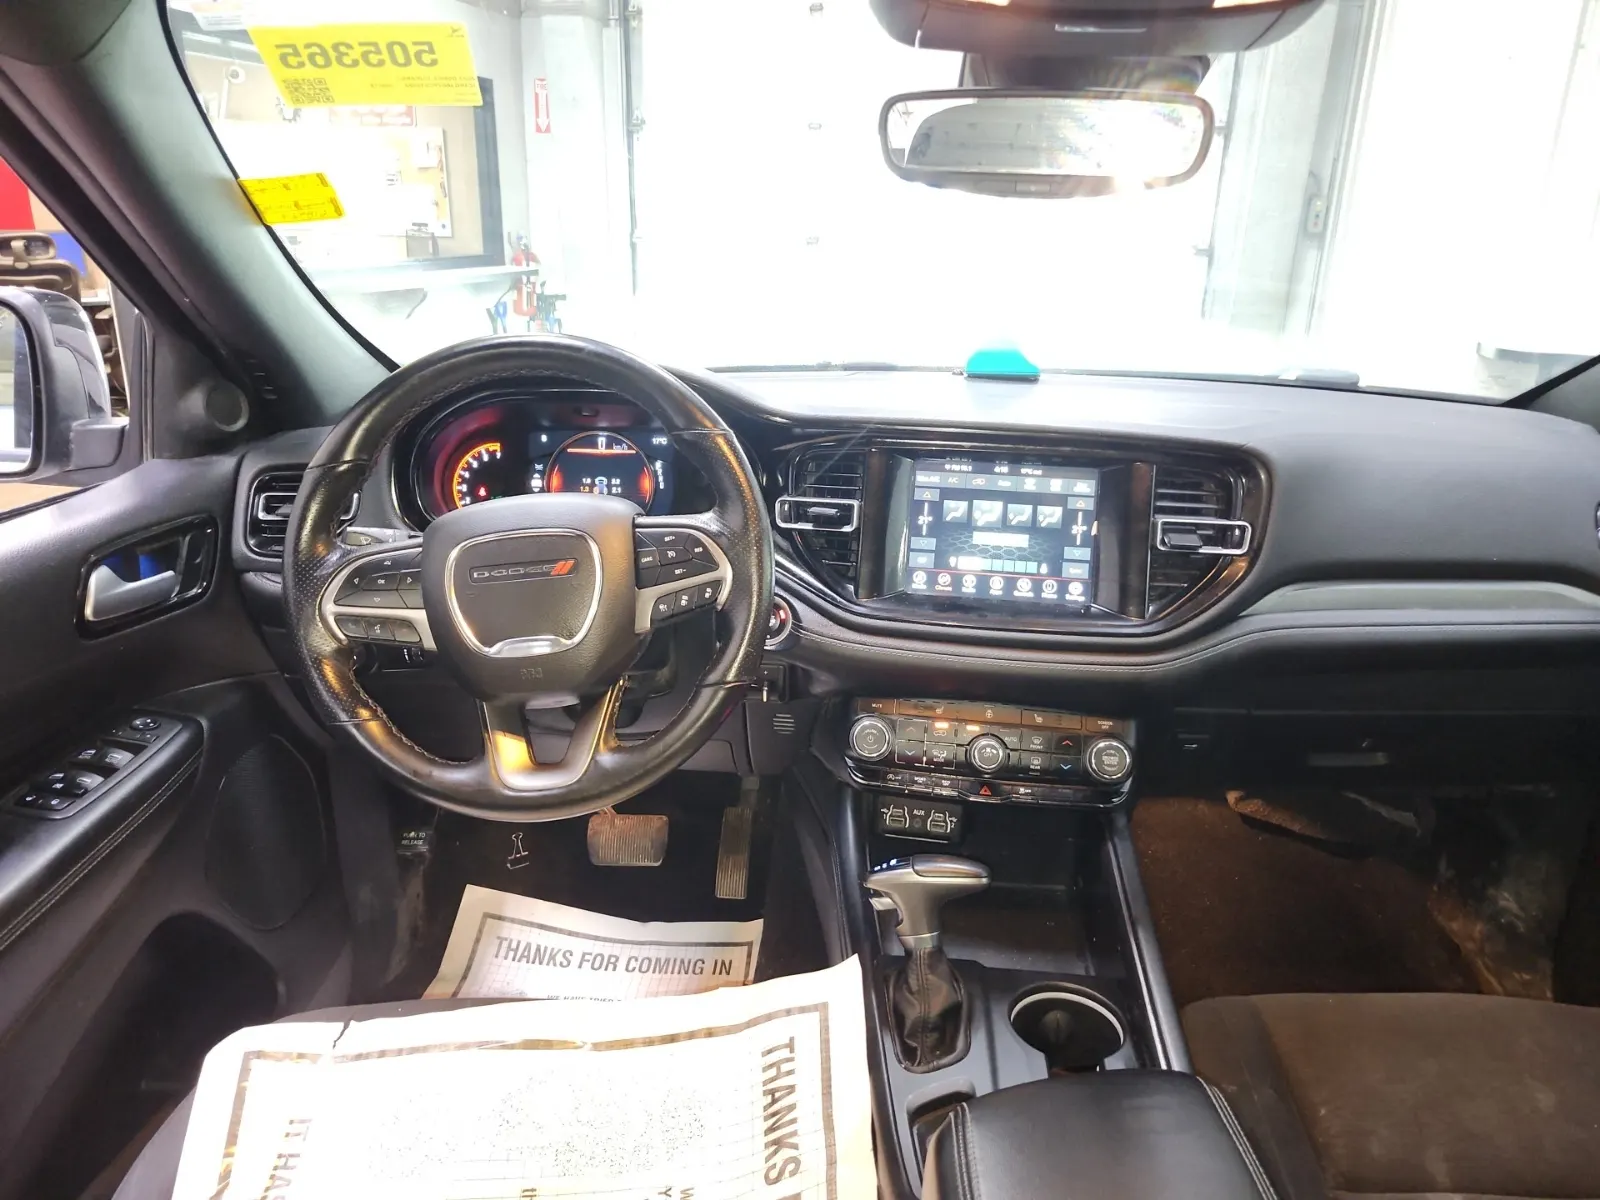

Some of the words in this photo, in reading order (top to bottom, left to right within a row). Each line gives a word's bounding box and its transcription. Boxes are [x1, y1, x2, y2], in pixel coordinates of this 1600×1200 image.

[473, 564, 556, 579] DODGE
[913, 808, 926, 817] AUX
[494, 935, 574, 969] THANKS
[578, 952, 620, 972] FOR
[625, 955, 705, 976] COMING
[711, 959, 734, 977] IN
[761, 1036, 802, 1187] THANKS
[284, 1118, 313, 1142] IT
